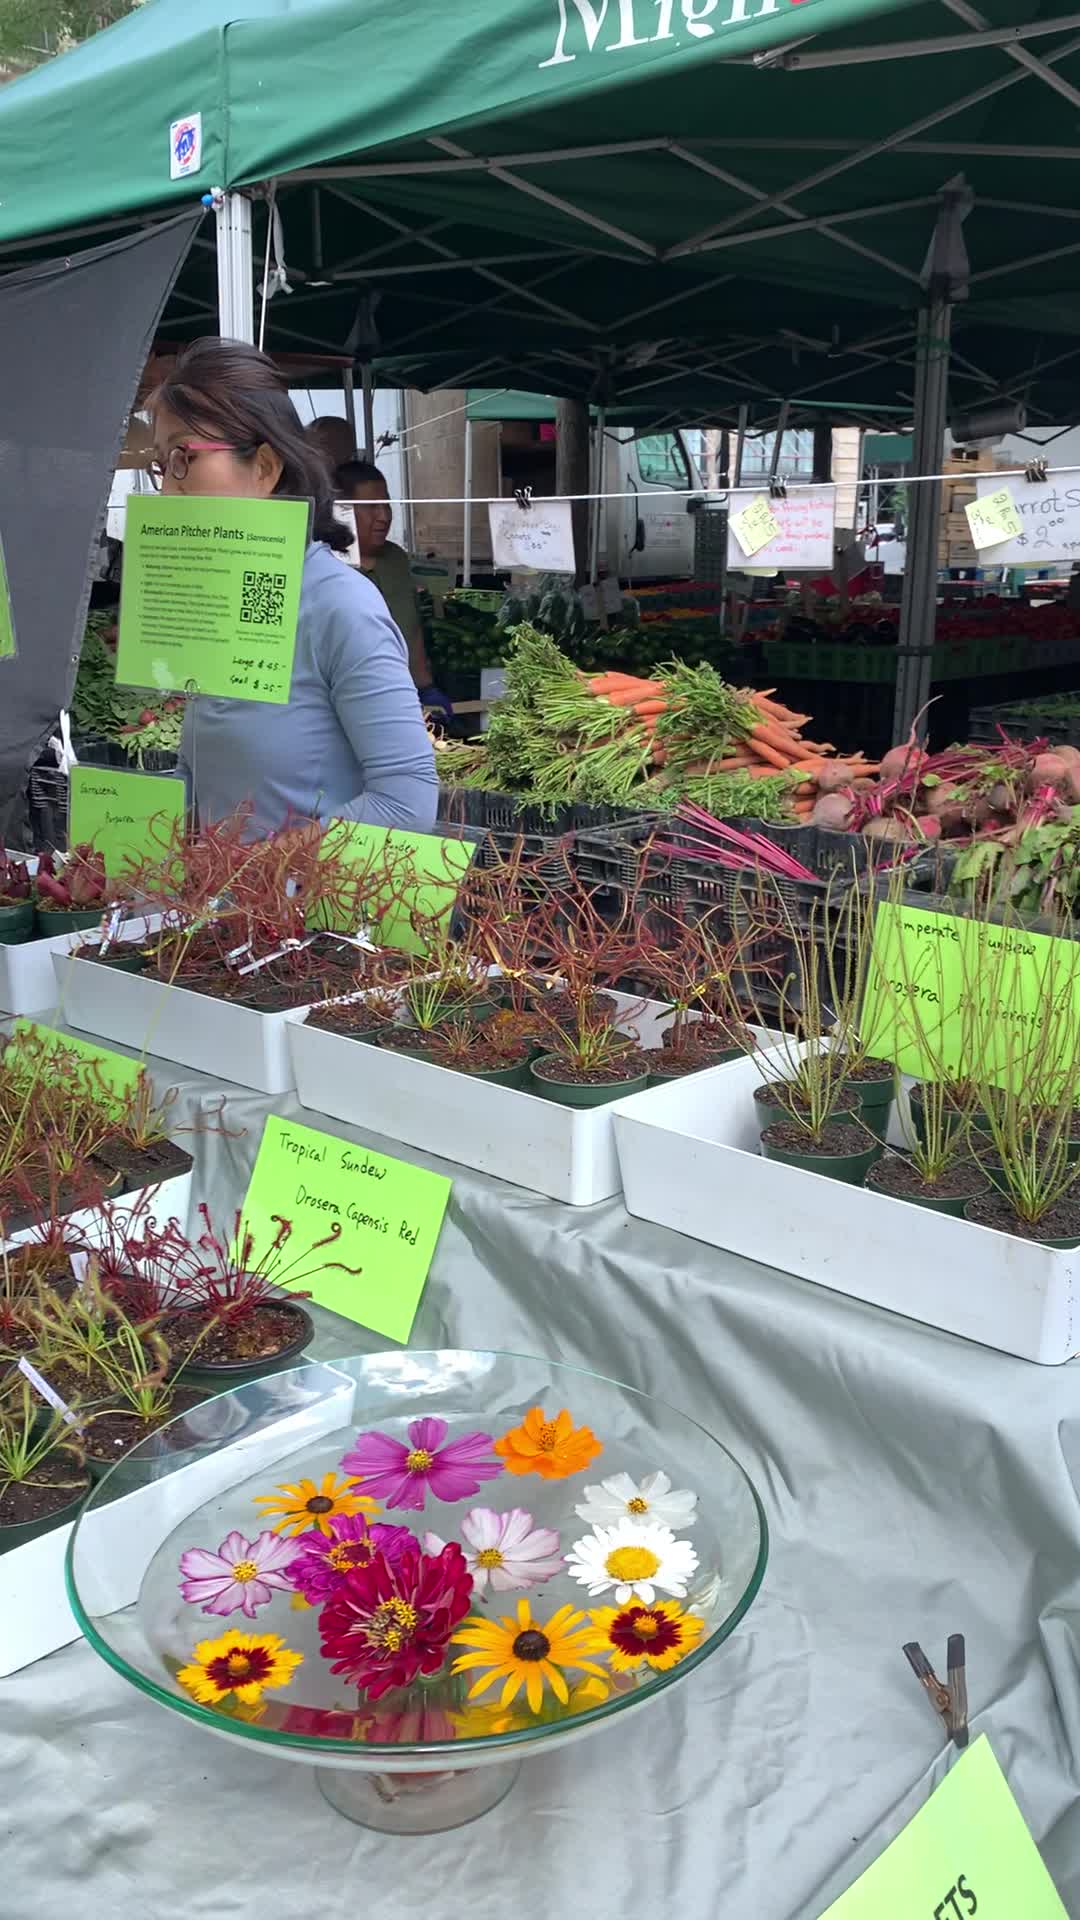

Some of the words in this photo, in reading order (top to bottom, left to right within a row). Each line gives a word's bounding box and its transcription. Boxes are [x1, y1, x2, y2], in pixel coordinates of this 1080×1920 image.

[140, 524, 180, 537] American
[180, 525, 211, 538] Pitcher
[213, 526, 245, 540] Plants
[895, 917, 960, 942] mperate
[279, 1132, 327, 1165] Tropical
[340, 1151, 387, 1180] Sundew
[295, 1184, 340, 1215] Drosera
[346, 1202, 389, 1233] Capensis
[398, 1220, 420, 1246] Red
